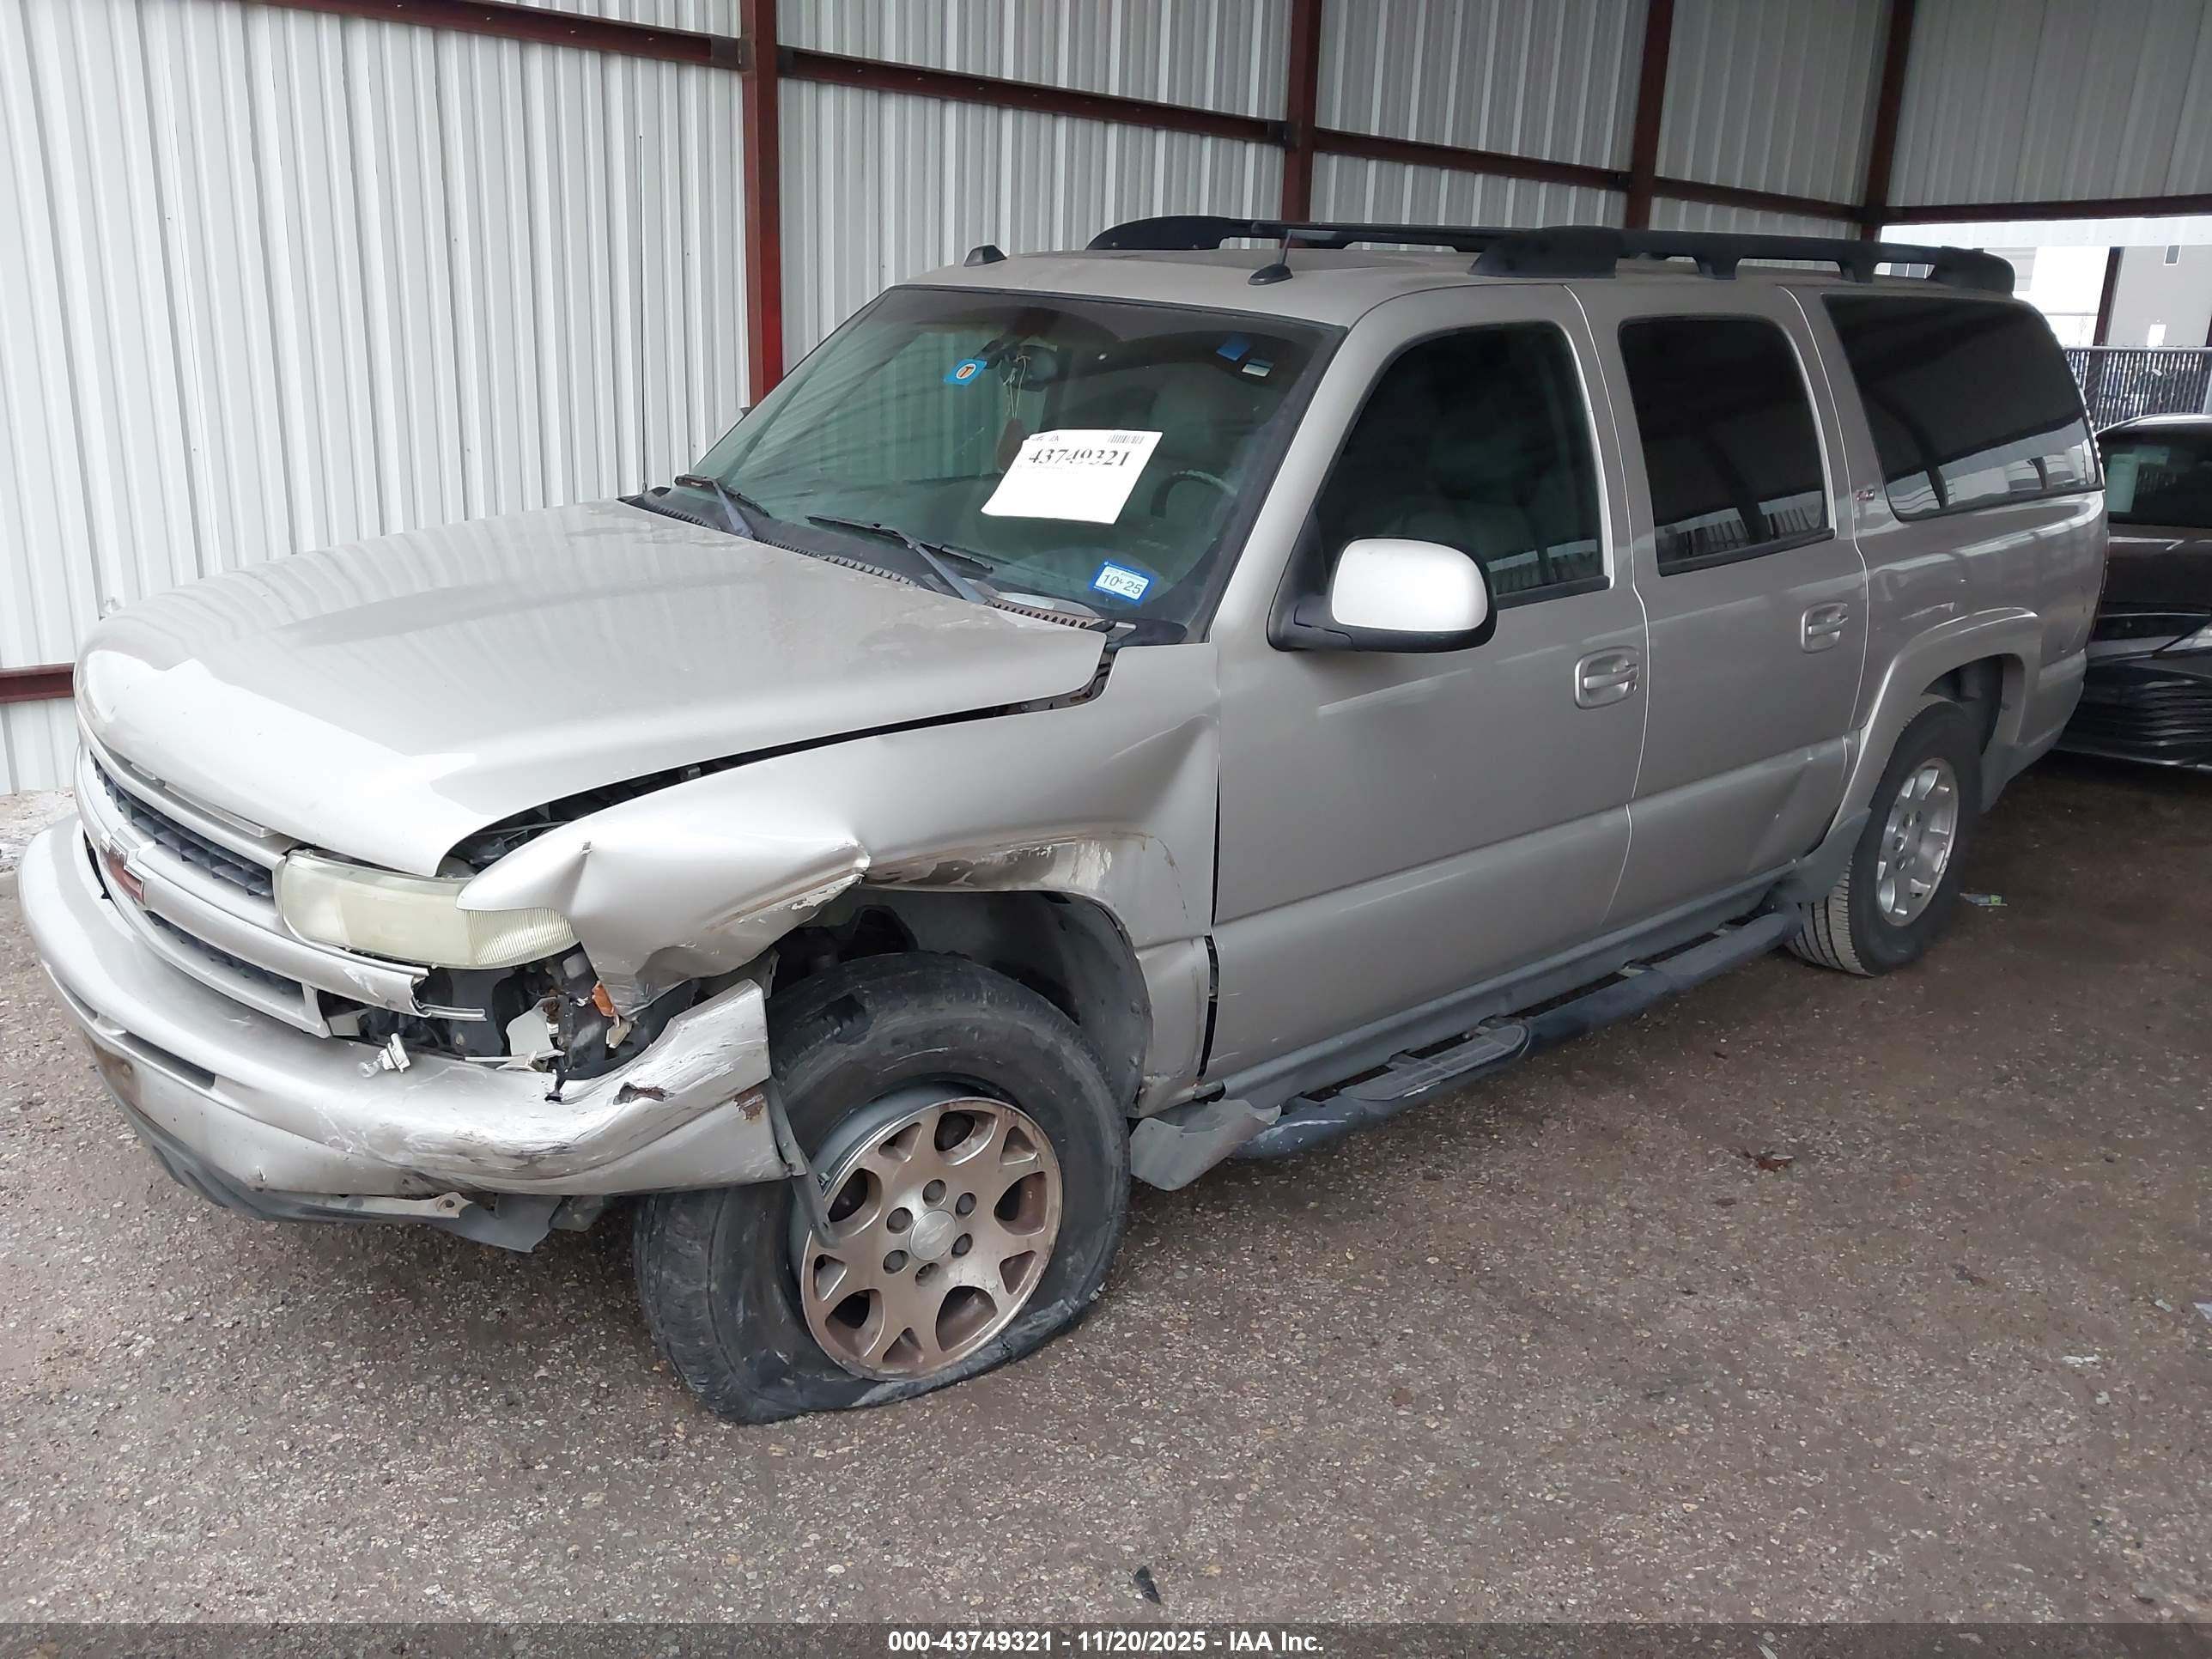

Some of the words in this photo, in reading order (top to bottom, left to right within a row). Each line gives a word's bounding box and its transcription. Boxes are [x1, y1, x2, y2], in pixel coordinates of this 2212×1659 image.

[1028, 447, 1132, 466] 43749321
[1103, 574, 1120, 586] 10
[1122, 580, 1143, 594] 25
